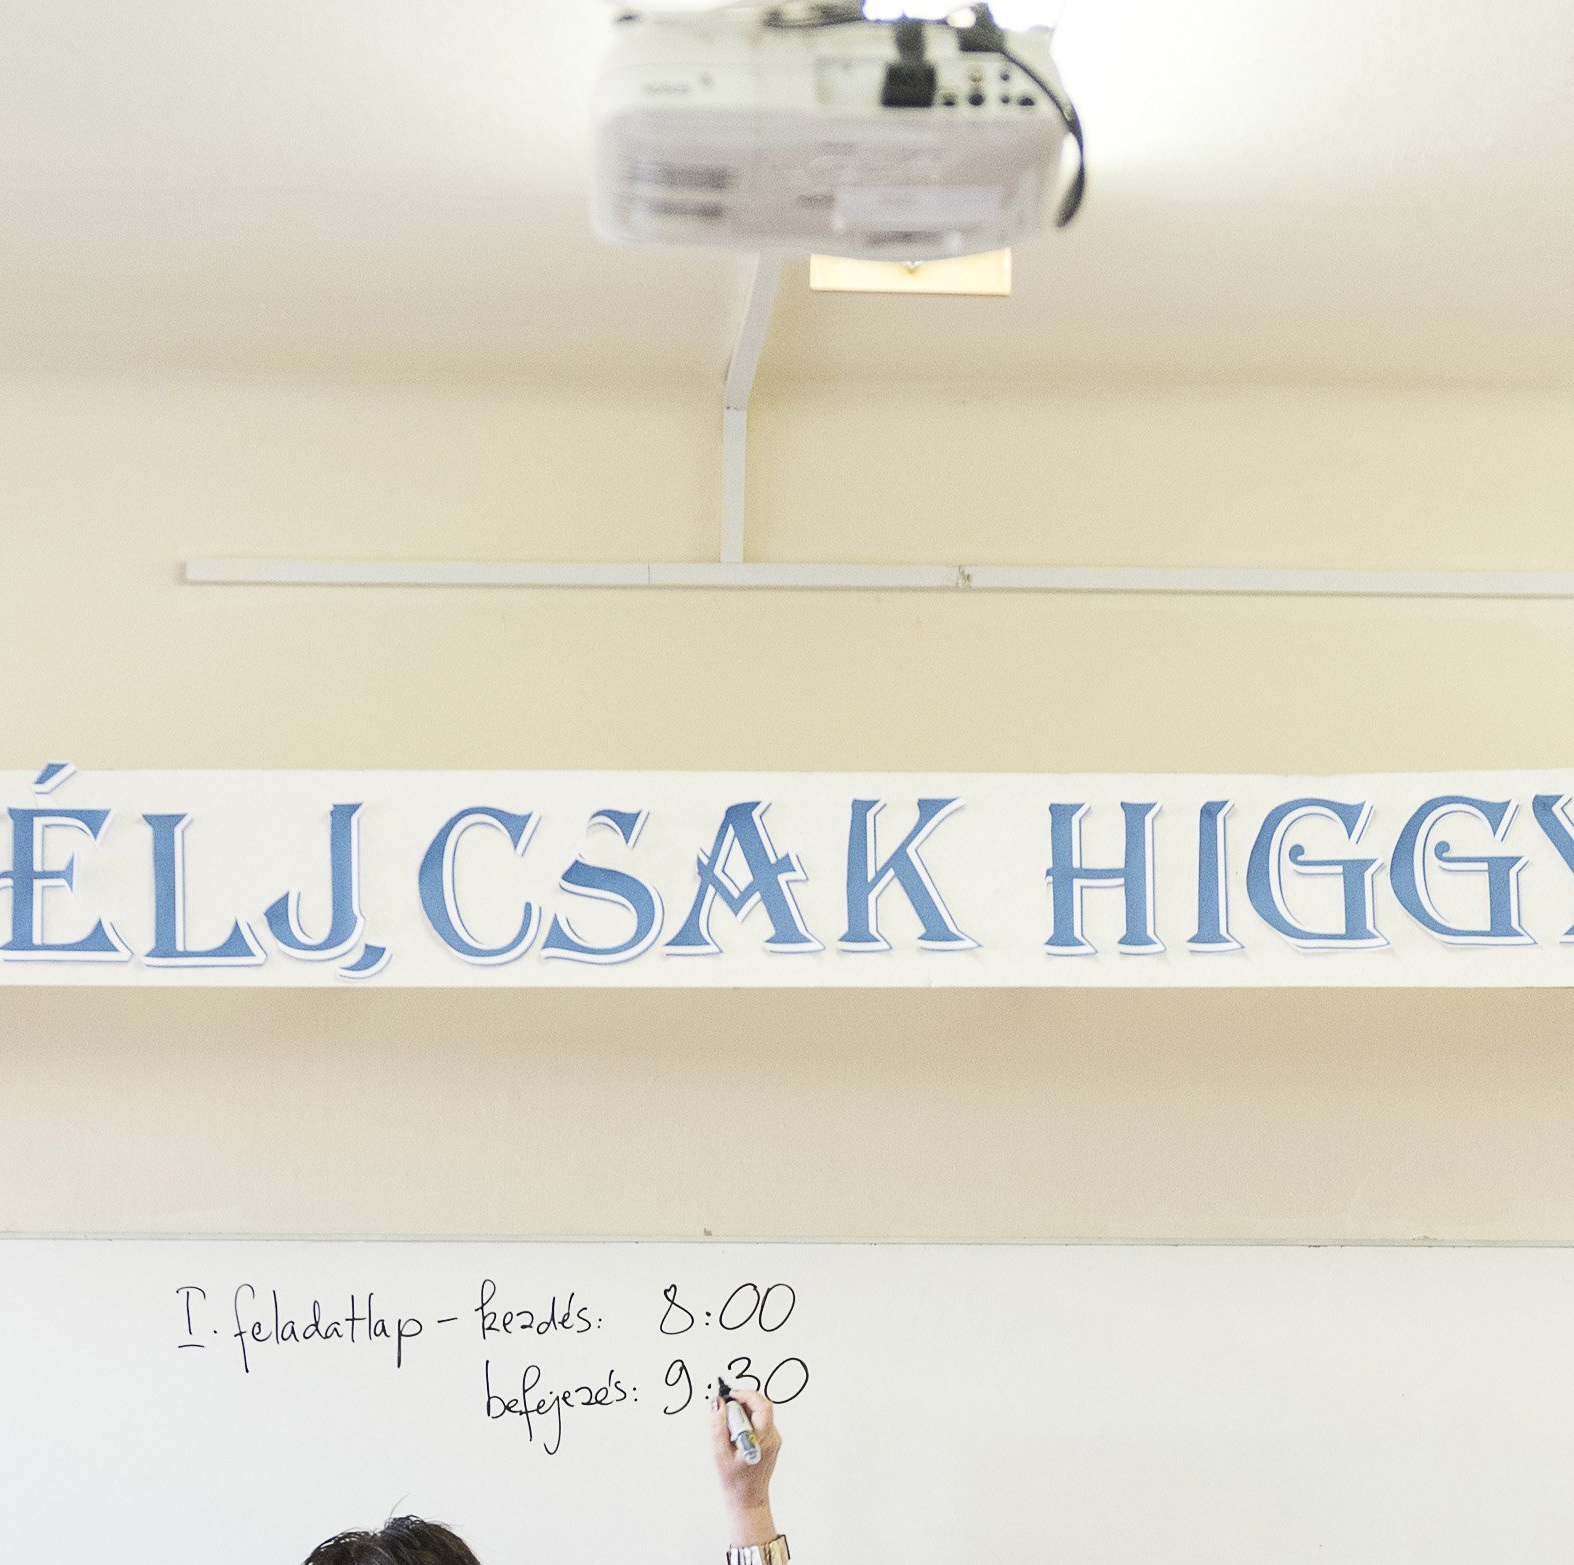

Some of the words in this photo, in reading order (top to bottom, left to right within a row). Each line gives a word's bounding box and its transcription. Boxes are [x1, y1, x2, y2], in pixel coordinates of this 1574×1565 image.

[417, 798, 984, 967] CSAK
[176, 1285, 219, 1349] I.
[232, 1282, 424, 1374] feladatlap
[475, 1278, 605, 1341] kezdés:
[658, 1282, 797, 1336] 8:00
[484, 1360, 639, 1456] befejezés:
[662, 1356, 811, 1416] 9:30
